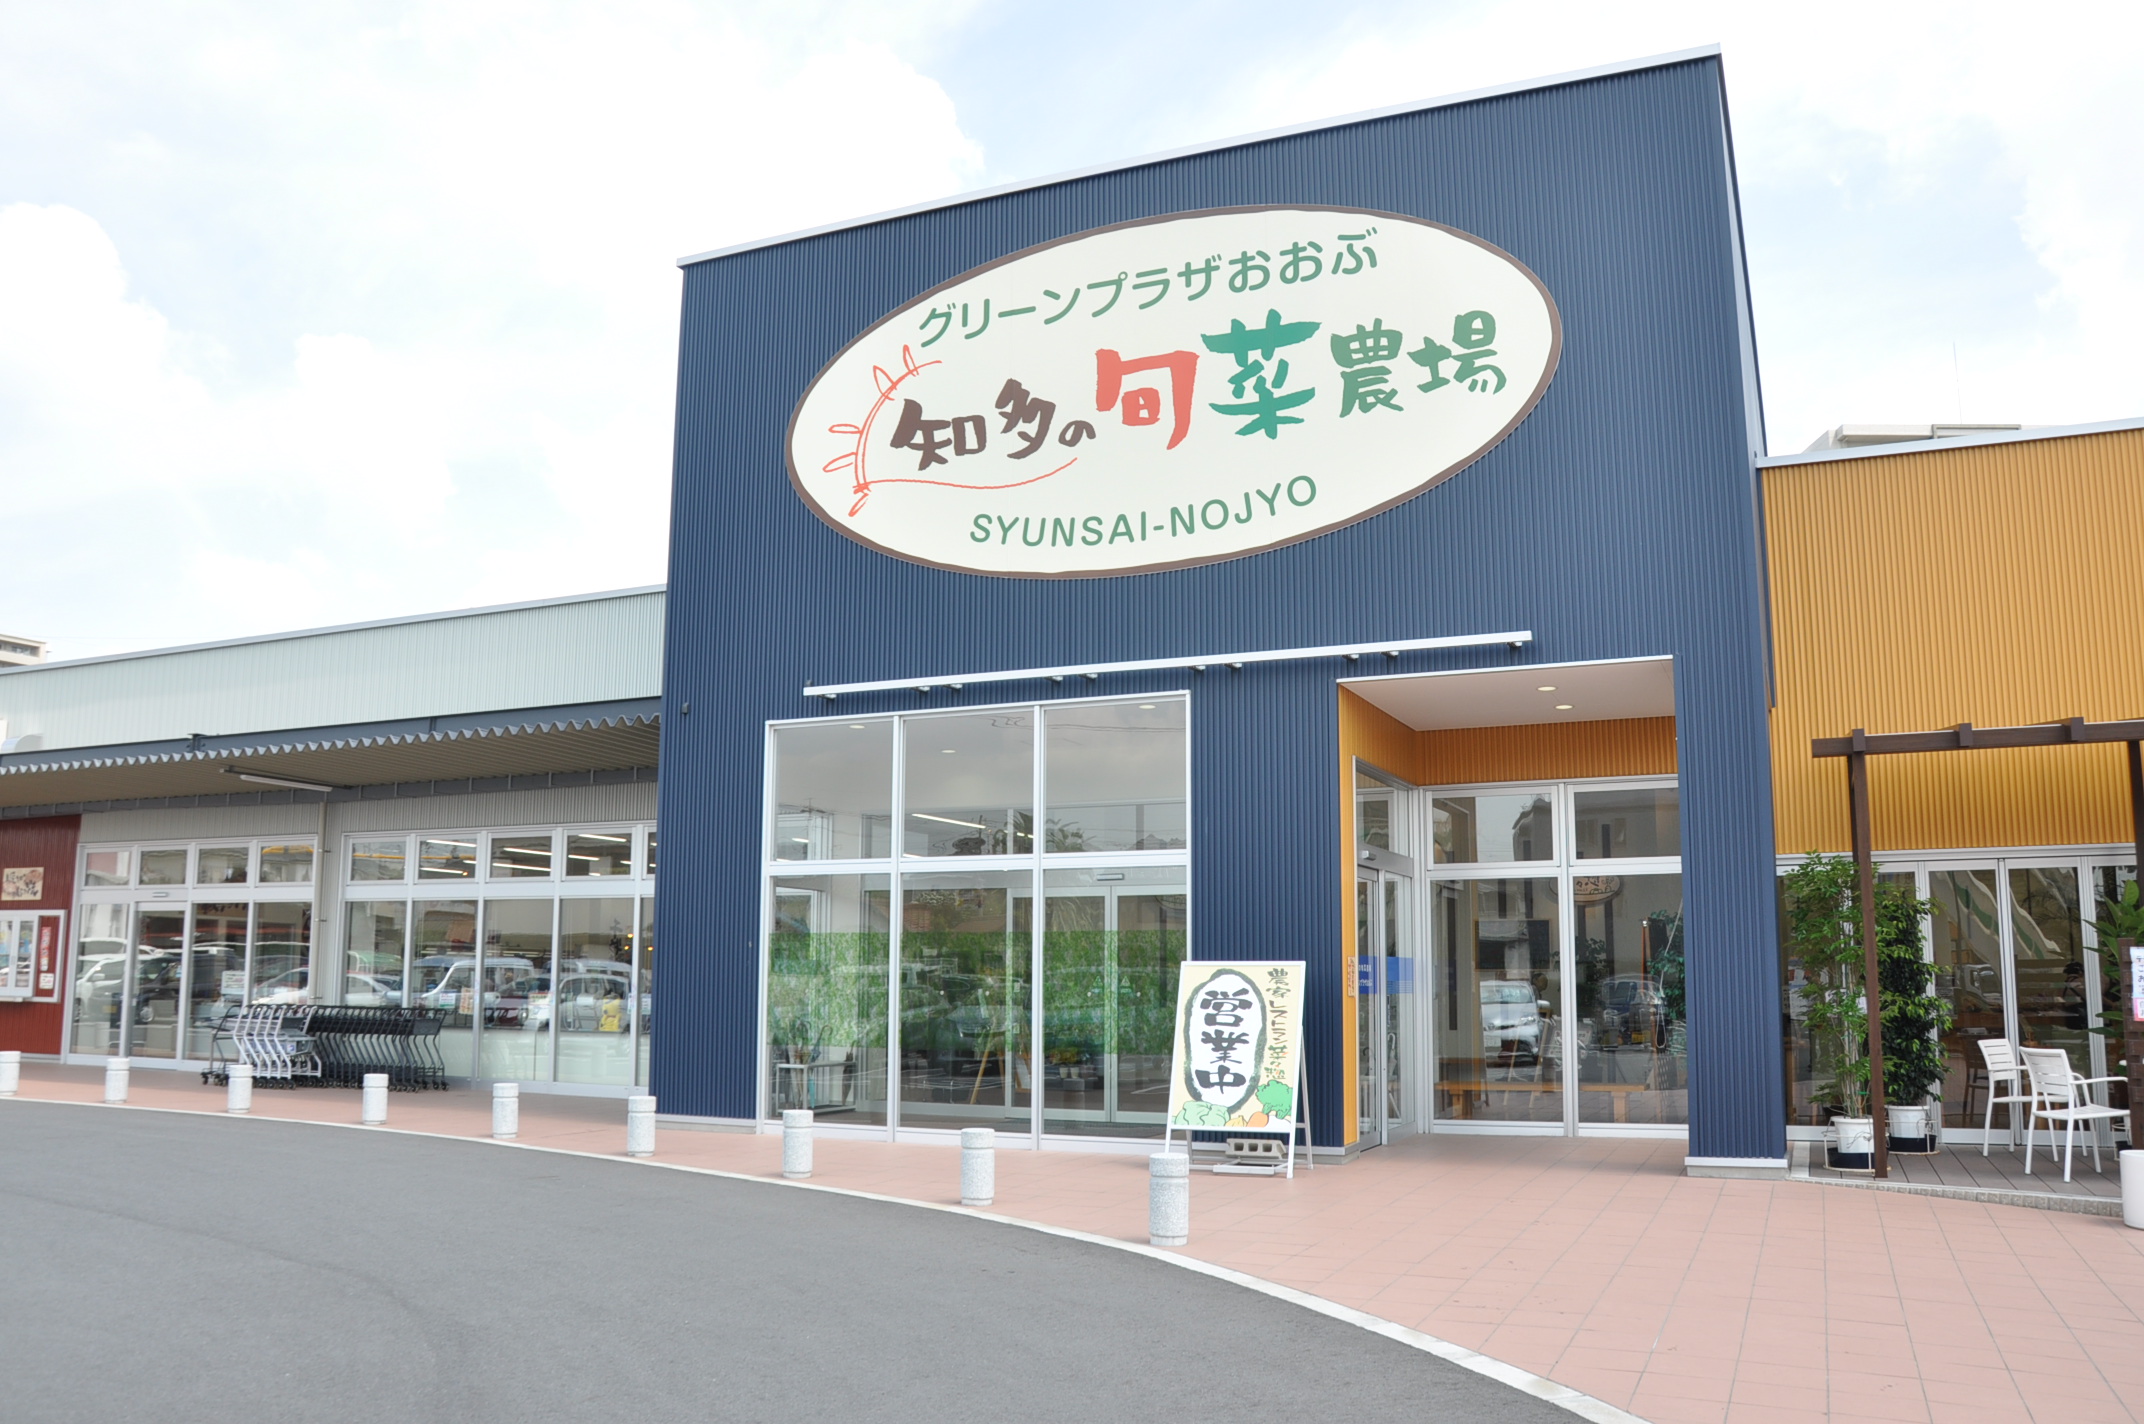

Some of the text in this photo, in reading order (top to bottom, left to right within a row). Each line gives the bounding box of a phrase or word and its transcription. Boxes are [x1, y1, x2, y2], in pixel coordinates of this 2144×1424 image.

[918, 226, 1378, 348] グリーンプラザおおぶ
[889, 308, 1507, 470] 知多の旬菜農場
[970, 475, 1317, 547] SYUNSAI-NOJYO
[1195, 987, 1253, 1094] 営業中
